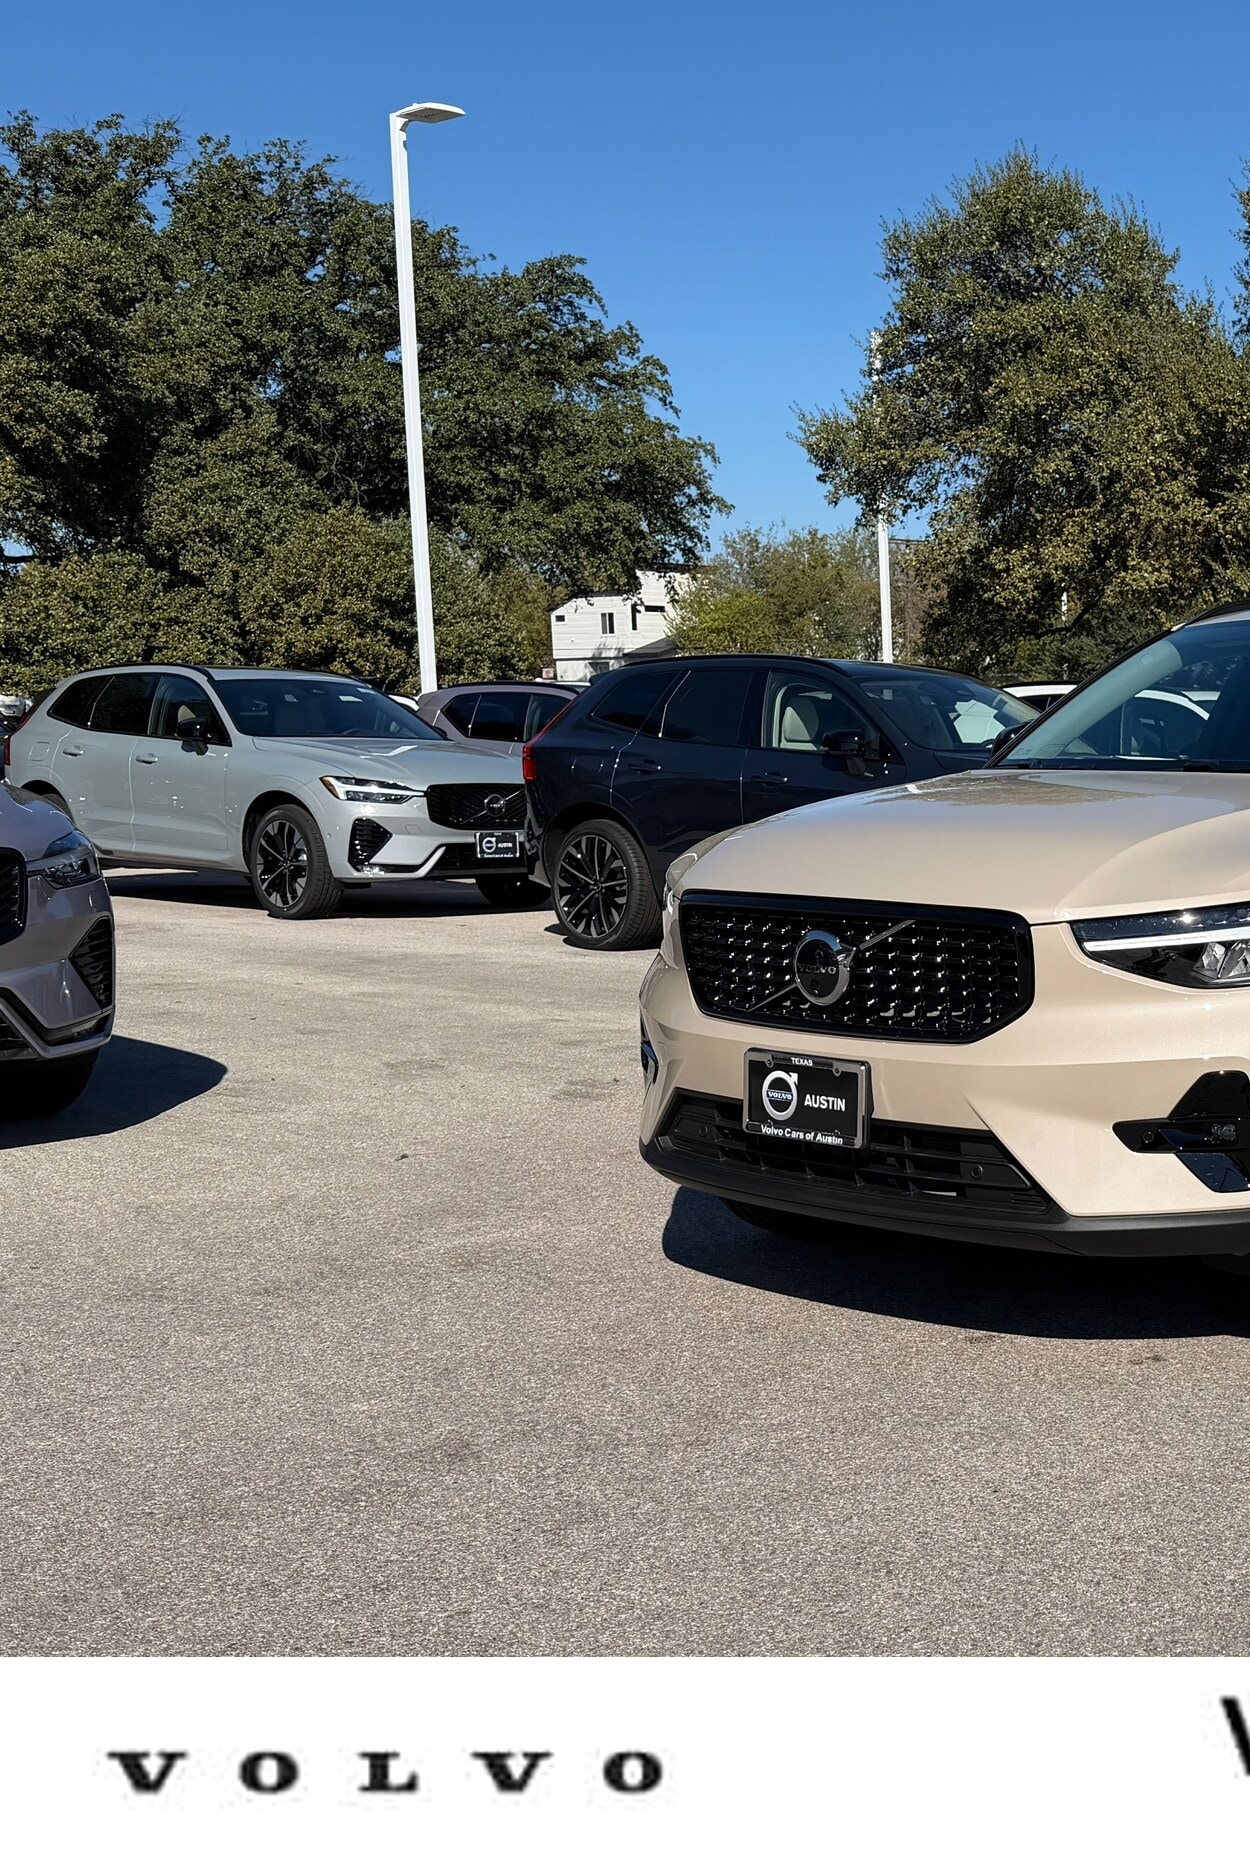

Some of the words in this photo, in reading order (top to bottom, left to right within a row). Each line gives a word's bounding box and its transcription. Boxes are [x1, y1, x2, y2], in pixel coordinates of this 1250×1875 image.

[797, 962, 837, 975] VOLVO
[791, 1057, 813, 1067] TEXAS
[767, 1091, 792, 1100] VOLVO
[804, 1094, 846, 1112] AUSTIN
[760, 1124, 784, 1137] Volvo
[784, 1128, 804, 1140] Cars
[805, 1131, 816, 1141] of
[815, 1133, 843, 1146] Austin
